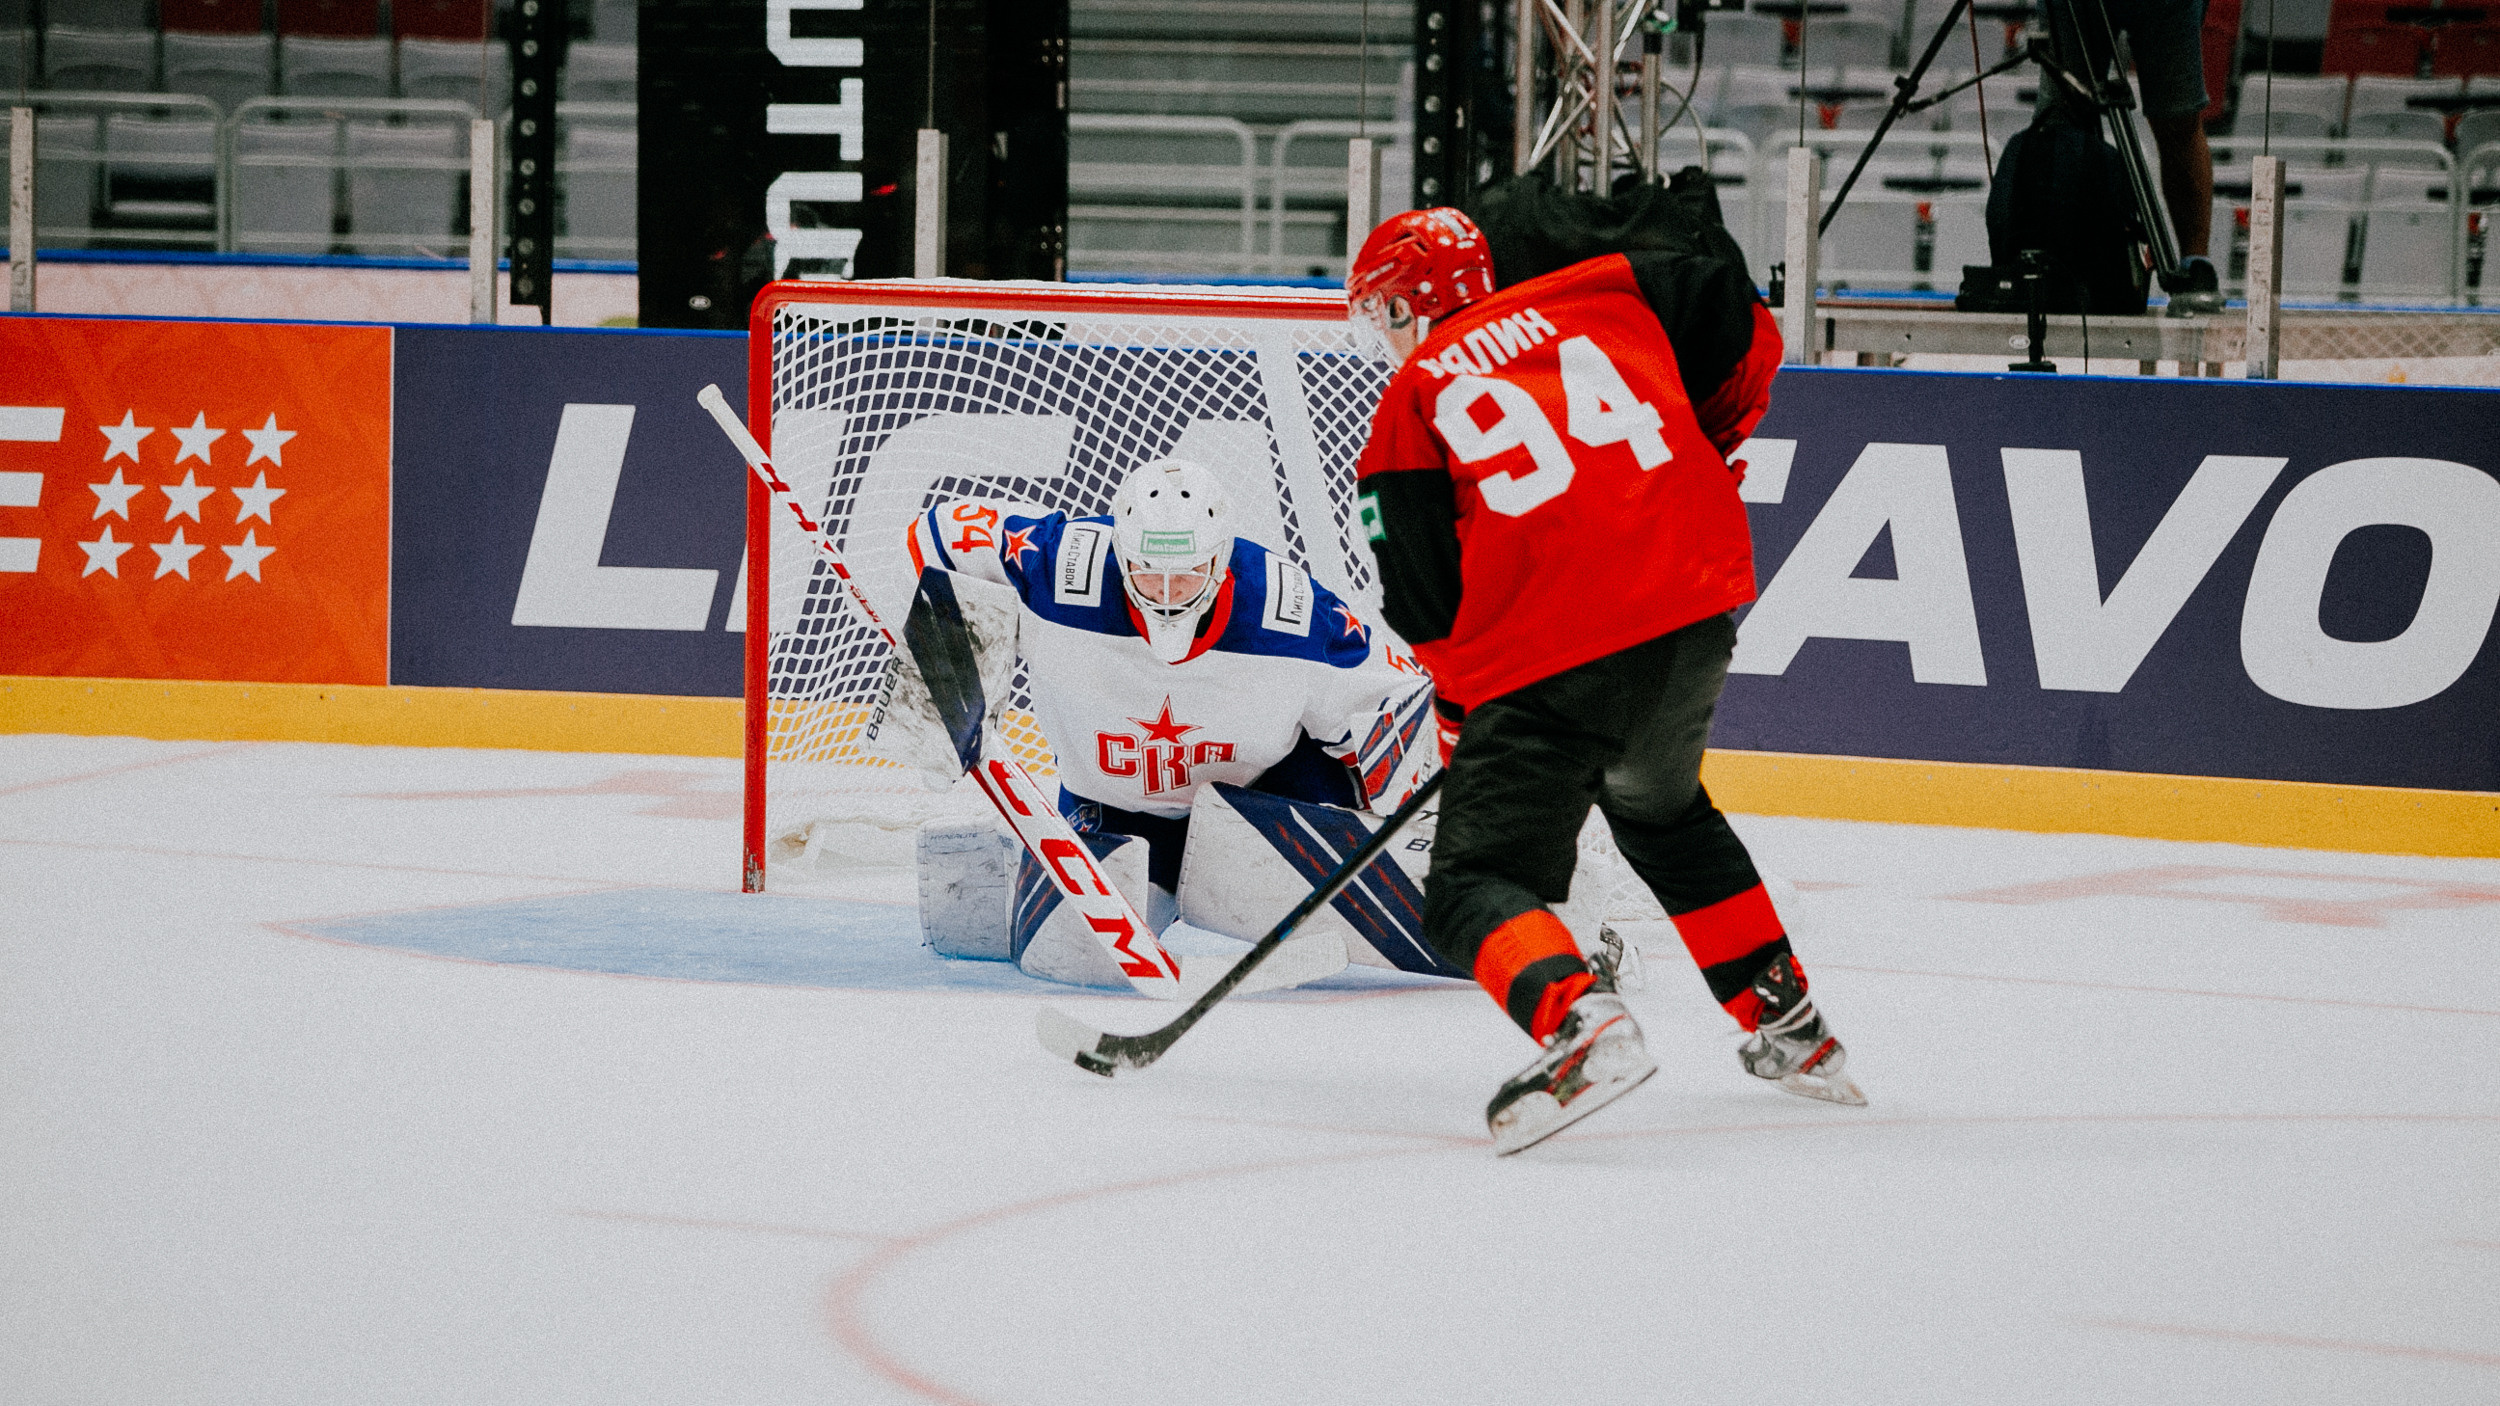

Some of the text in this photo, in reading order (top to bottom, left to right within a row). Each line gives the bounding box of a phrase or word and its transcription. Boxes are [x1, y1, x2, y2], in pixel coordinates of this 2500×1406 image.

[766, 0, 863, 281] UTU
[1433, 335, 1673, 518] 94
[1725, 438, 2500, 710] AVO
[988, 759, 1181, 985] CCM
[1094, 729, 1239, 796] СКА
